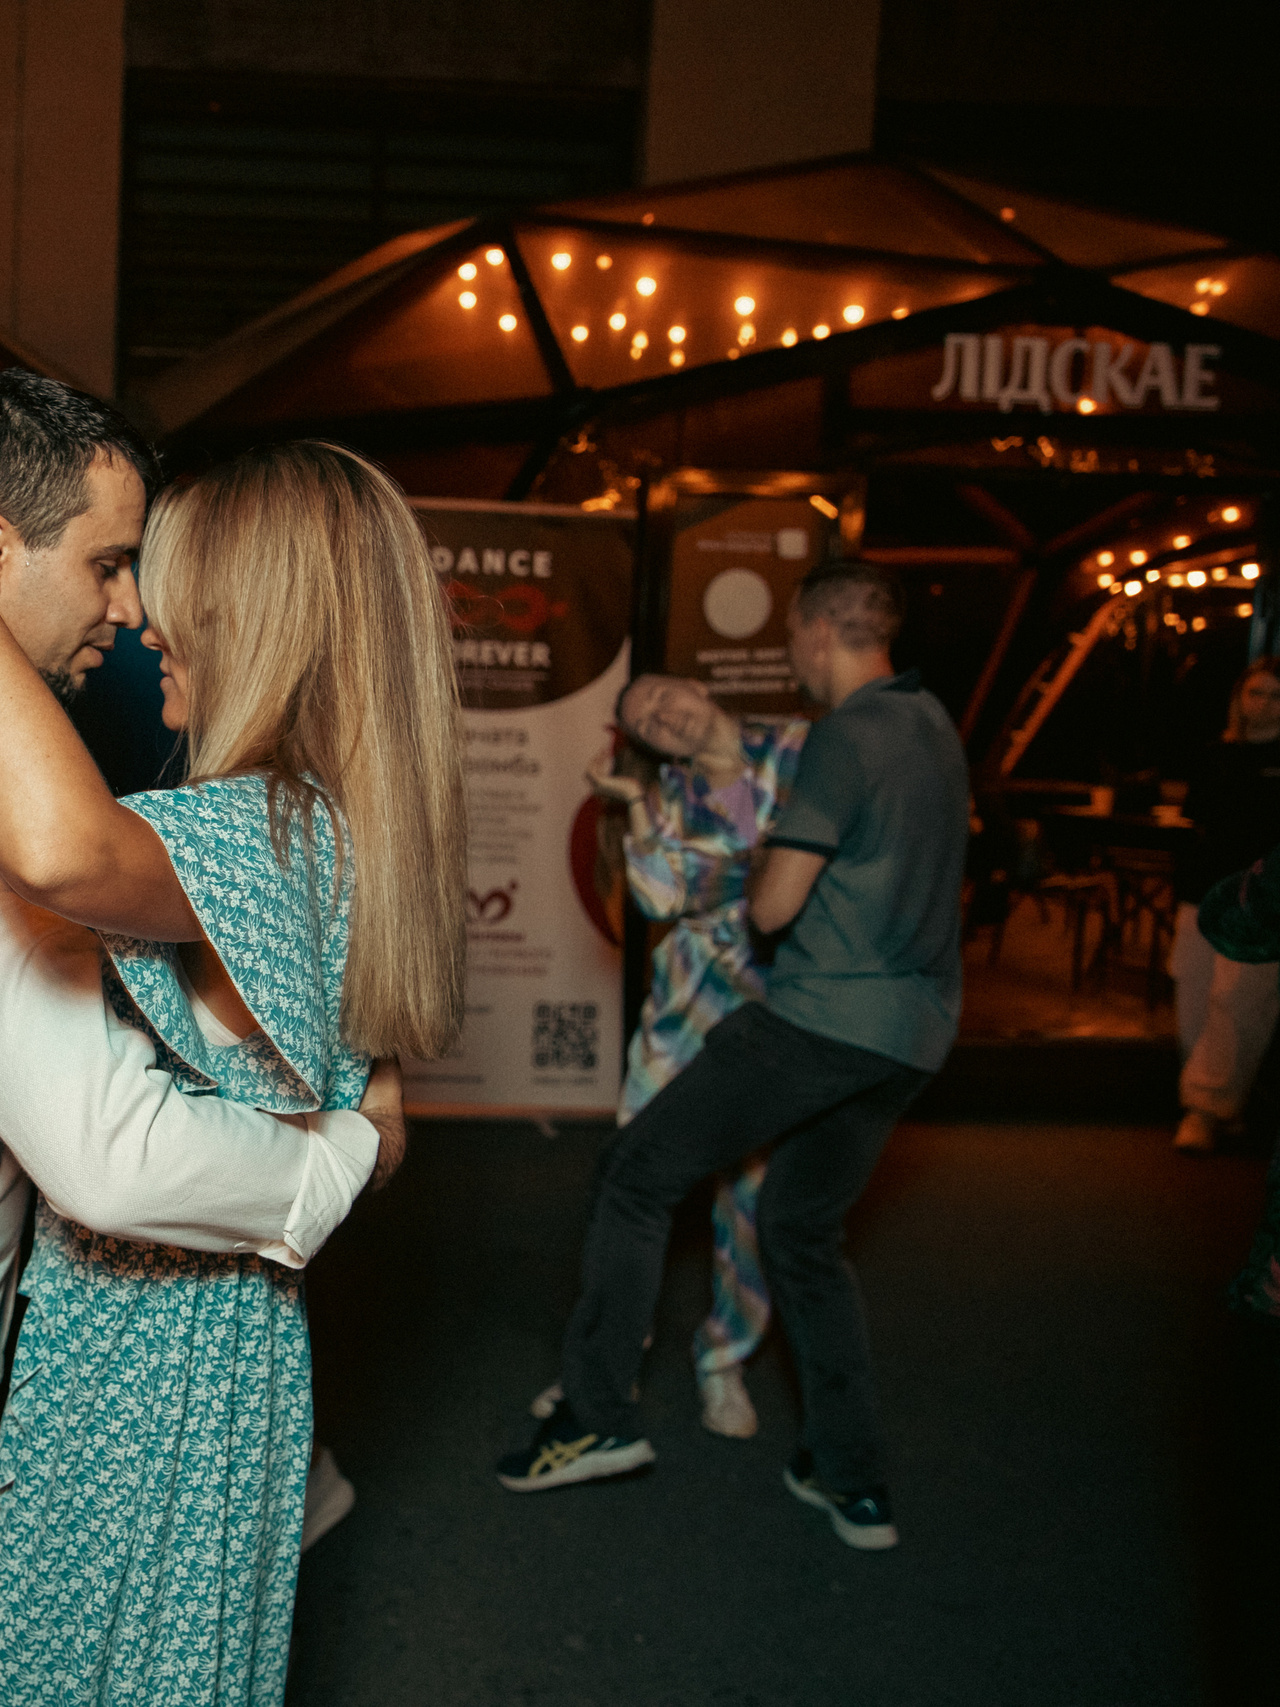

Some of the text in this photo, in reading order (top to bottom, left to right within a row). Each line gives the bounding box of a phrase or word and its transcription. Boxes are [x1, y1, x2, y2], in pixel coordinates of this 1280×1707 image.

[931, 332, 1222, 414] ЛІДСКАЕ
[431, 546, 553, 578] DANCE
[453, 638, 551, 667] REVER
